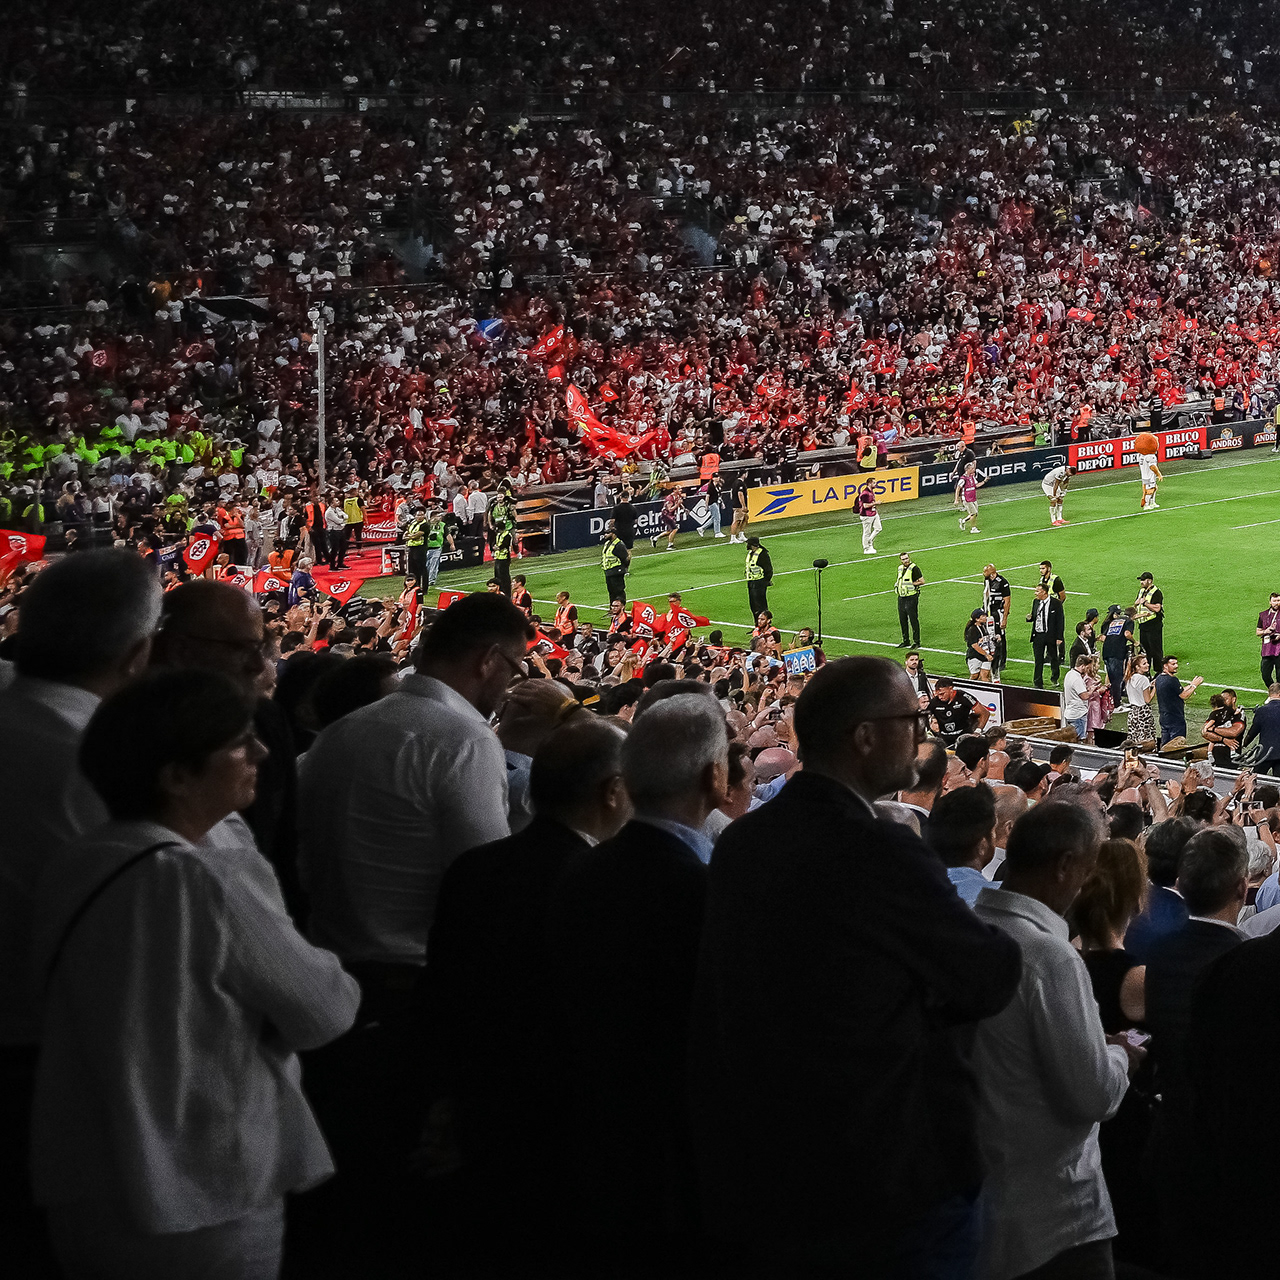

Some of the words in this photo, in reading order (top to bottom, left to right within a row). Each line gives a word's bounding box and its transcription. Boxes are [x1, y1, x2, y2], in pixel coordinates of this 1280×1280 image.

[1166, 430, 1199, 444] BRICO
[1211, 436, 1243, 449] ANDROS
[1077, 442, 1114, 458] BRICO
[1077, 454, 1114, 471] DEPÔT
[922, 461, 1027, 486] DEFNDER
[812, 487, 840, 505] LA
[440, 549, 464, 563] P14
